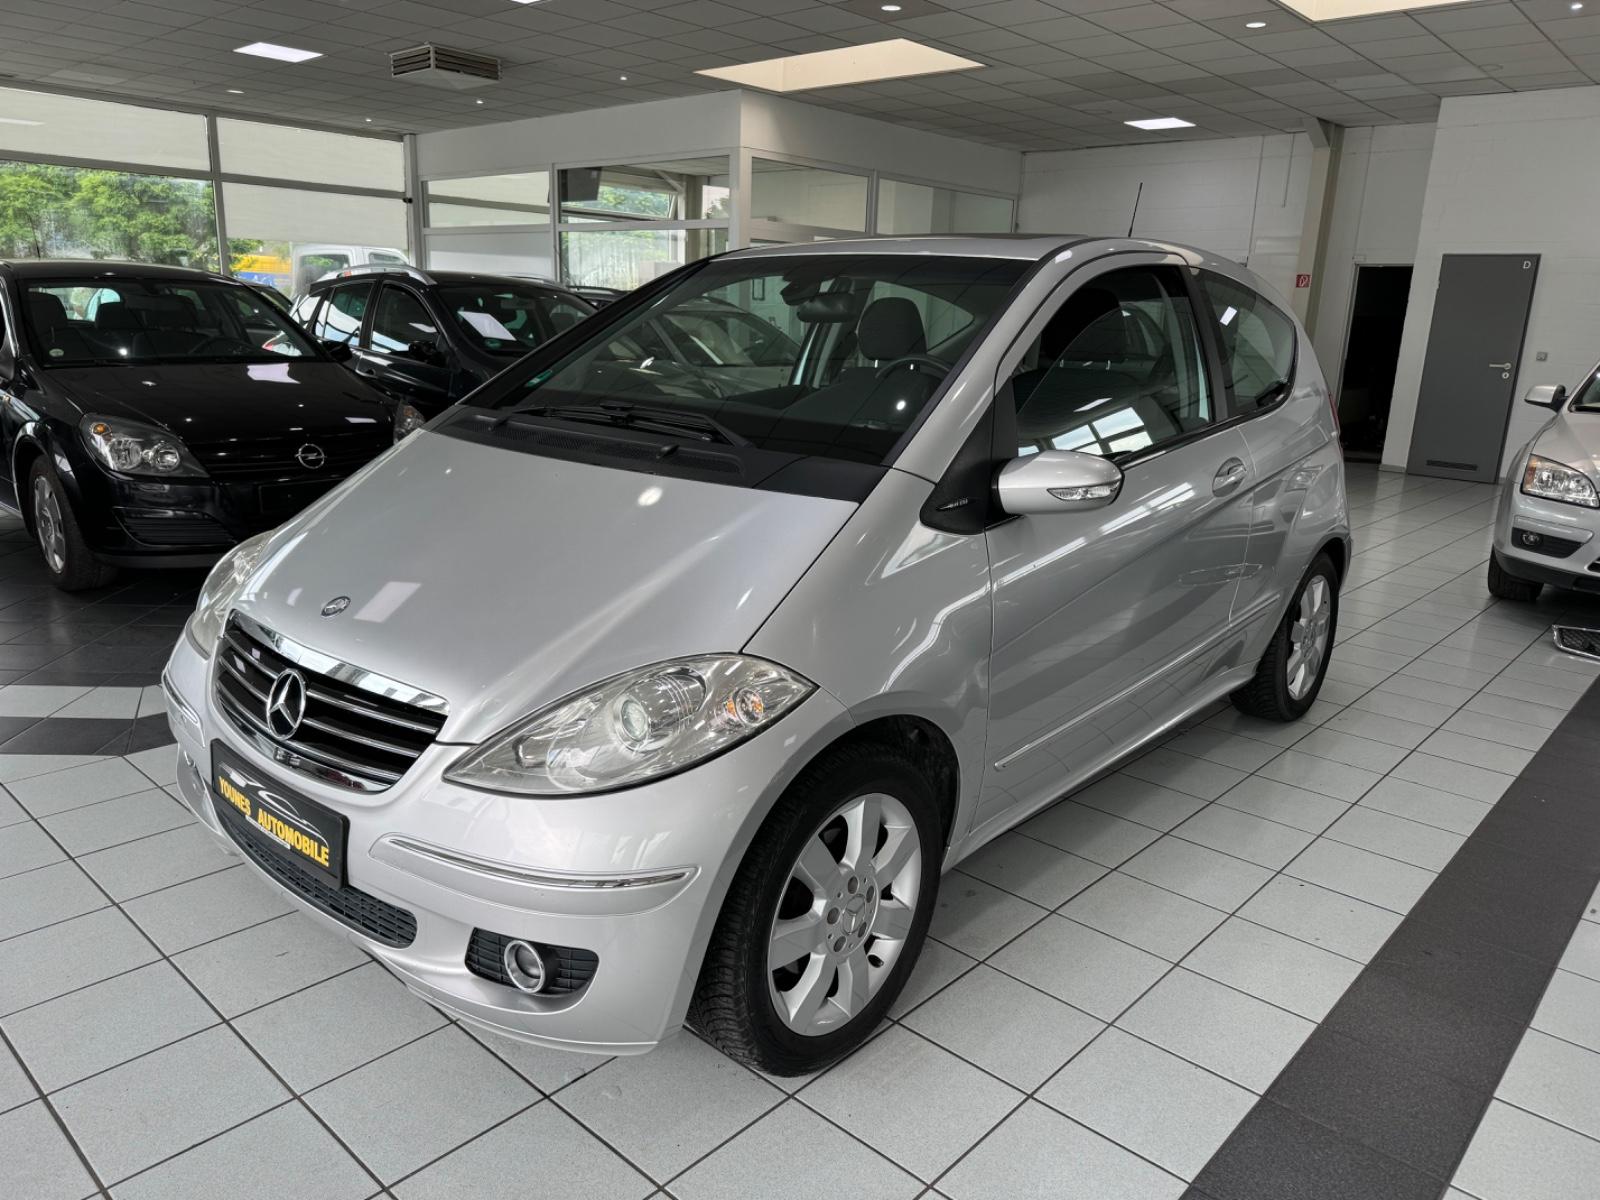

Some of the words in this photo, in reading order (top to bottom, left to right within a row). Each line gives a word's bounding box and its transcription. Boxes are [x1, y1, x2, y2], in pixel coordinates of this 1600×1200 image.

[1523, 260, 1532, 269] D
[218, 775, 252, 816] YOUNES
[258, 807, 330, 868] AUTOMOBILE
